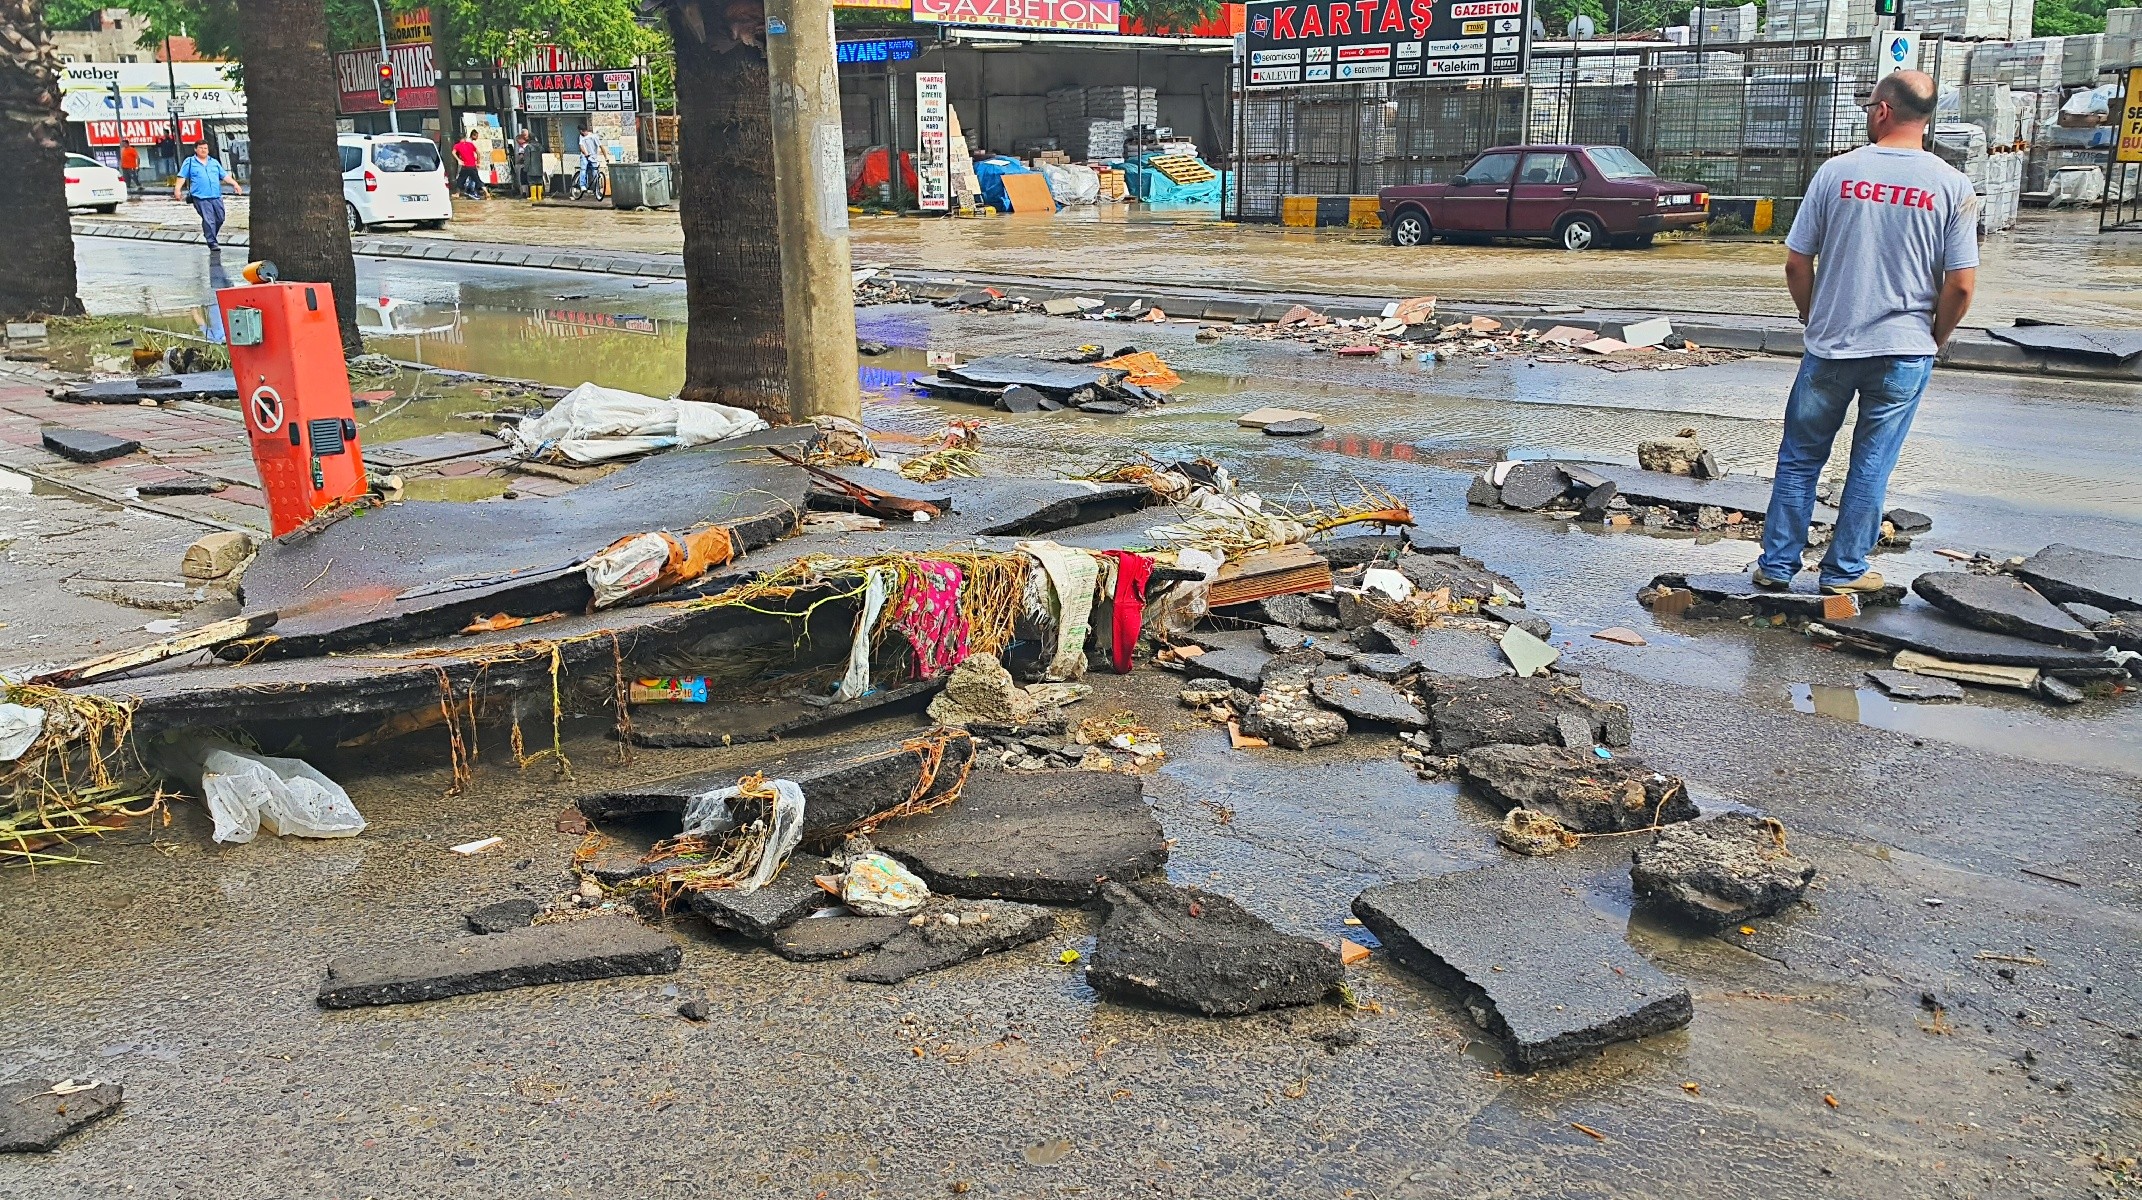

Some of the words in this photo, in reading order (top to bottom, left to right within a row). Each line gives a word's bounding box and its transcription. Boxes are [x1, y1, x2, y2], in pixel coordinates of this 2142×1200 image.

[922, 0, 1111, 24] GAZBETON
[1455, 2, 1518, 16] GAZBETON
[938, 14, 978, 23] DEPO
[987, 17, 1006, 25] VE
[1273, 0, 1434, 40] KARTAŞ
[68, 67, 119, 80] weber
[338, 50, 385, 93] SERAMİ
[386, 45, 435, 89] AYANS
[1260, 69, 1299, 81] KALEVİT
[1437, 62, 1480, 73] Kalekim
[533, 74, 593, 91] KARTAŞ
[1840, 180, 1936, 211] EGETEK
